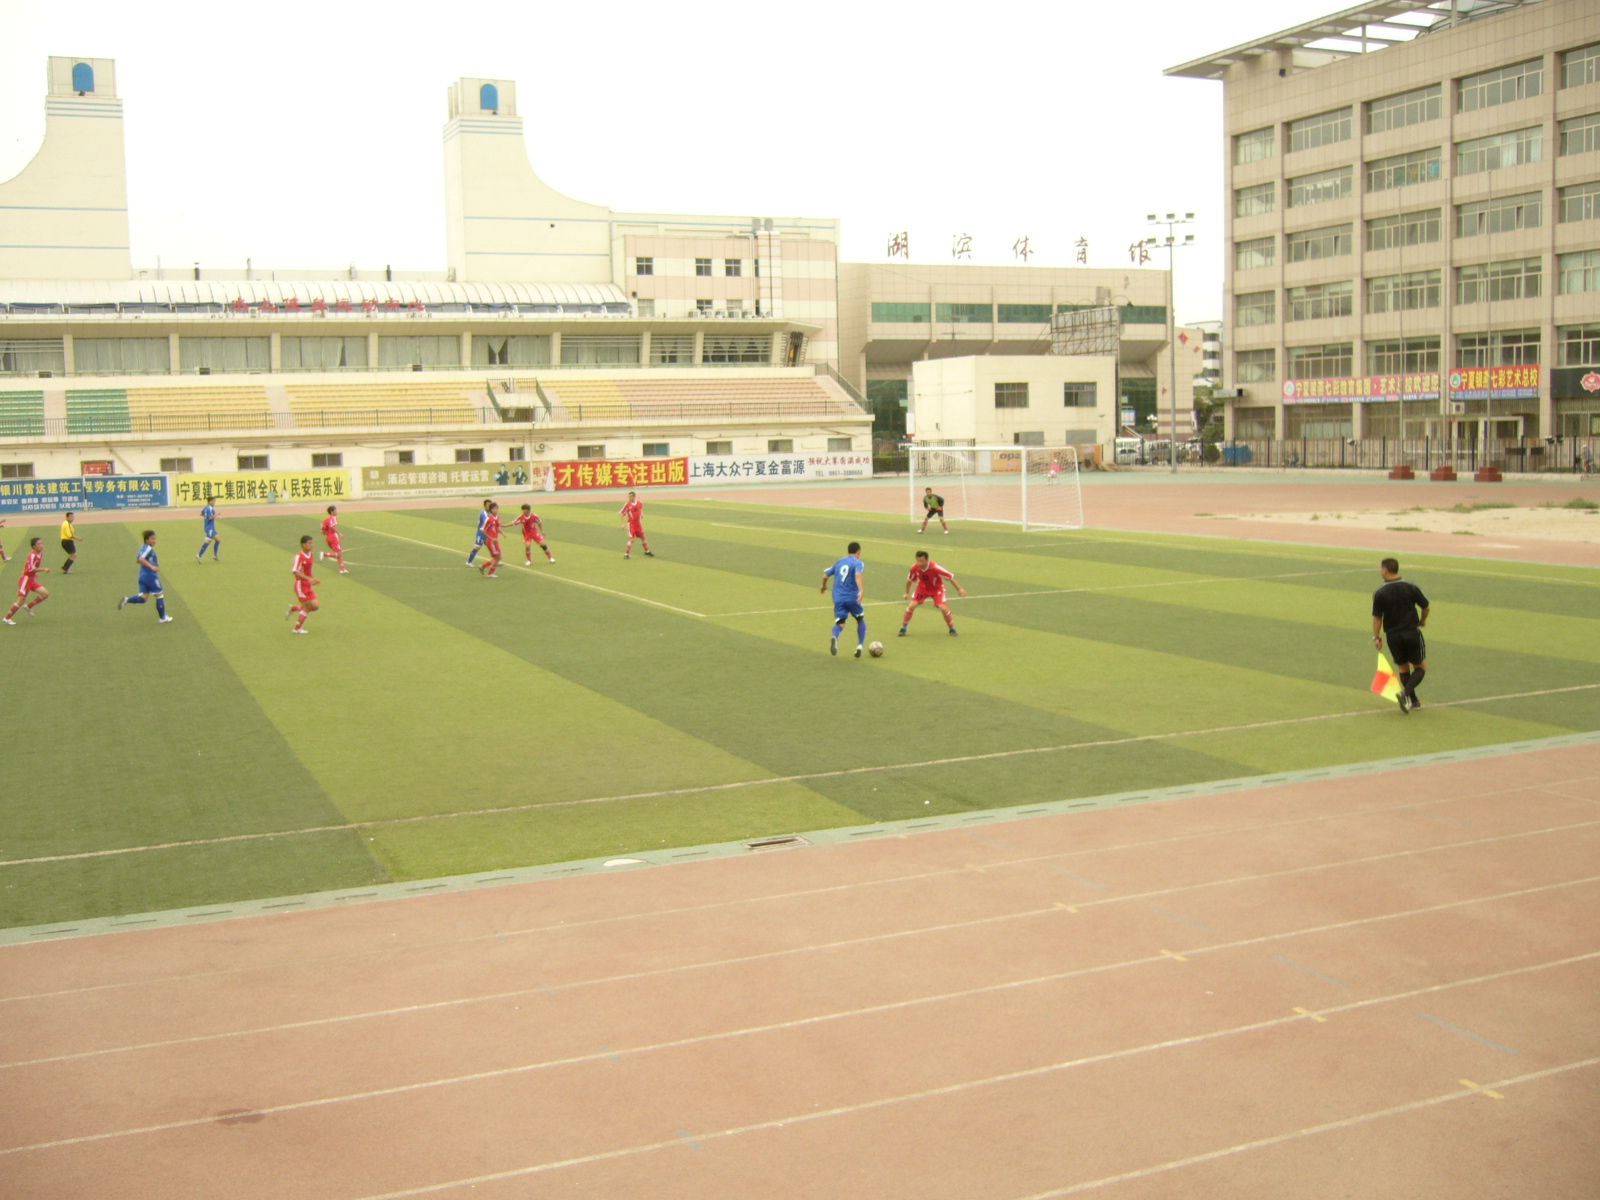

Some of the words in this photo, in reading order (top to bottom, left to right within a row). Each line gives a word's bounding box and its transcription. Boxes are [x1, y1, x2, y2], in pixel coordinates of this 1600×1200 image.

[887, 231, 1152, 266] 湖滨体育馆
[388, 471, 448, 485] 酒店管理咨询
[450, 469, 489, 483] 托管运营
[552, 460, 685, 488] 才传媒专注出版
[690, 459, 805, 477] 上海大众宁夏金富源
[180, 477, 343, 501] 宁夏建工集团祝全区人民安居乐业
[840, 564, 850, 582] 9
